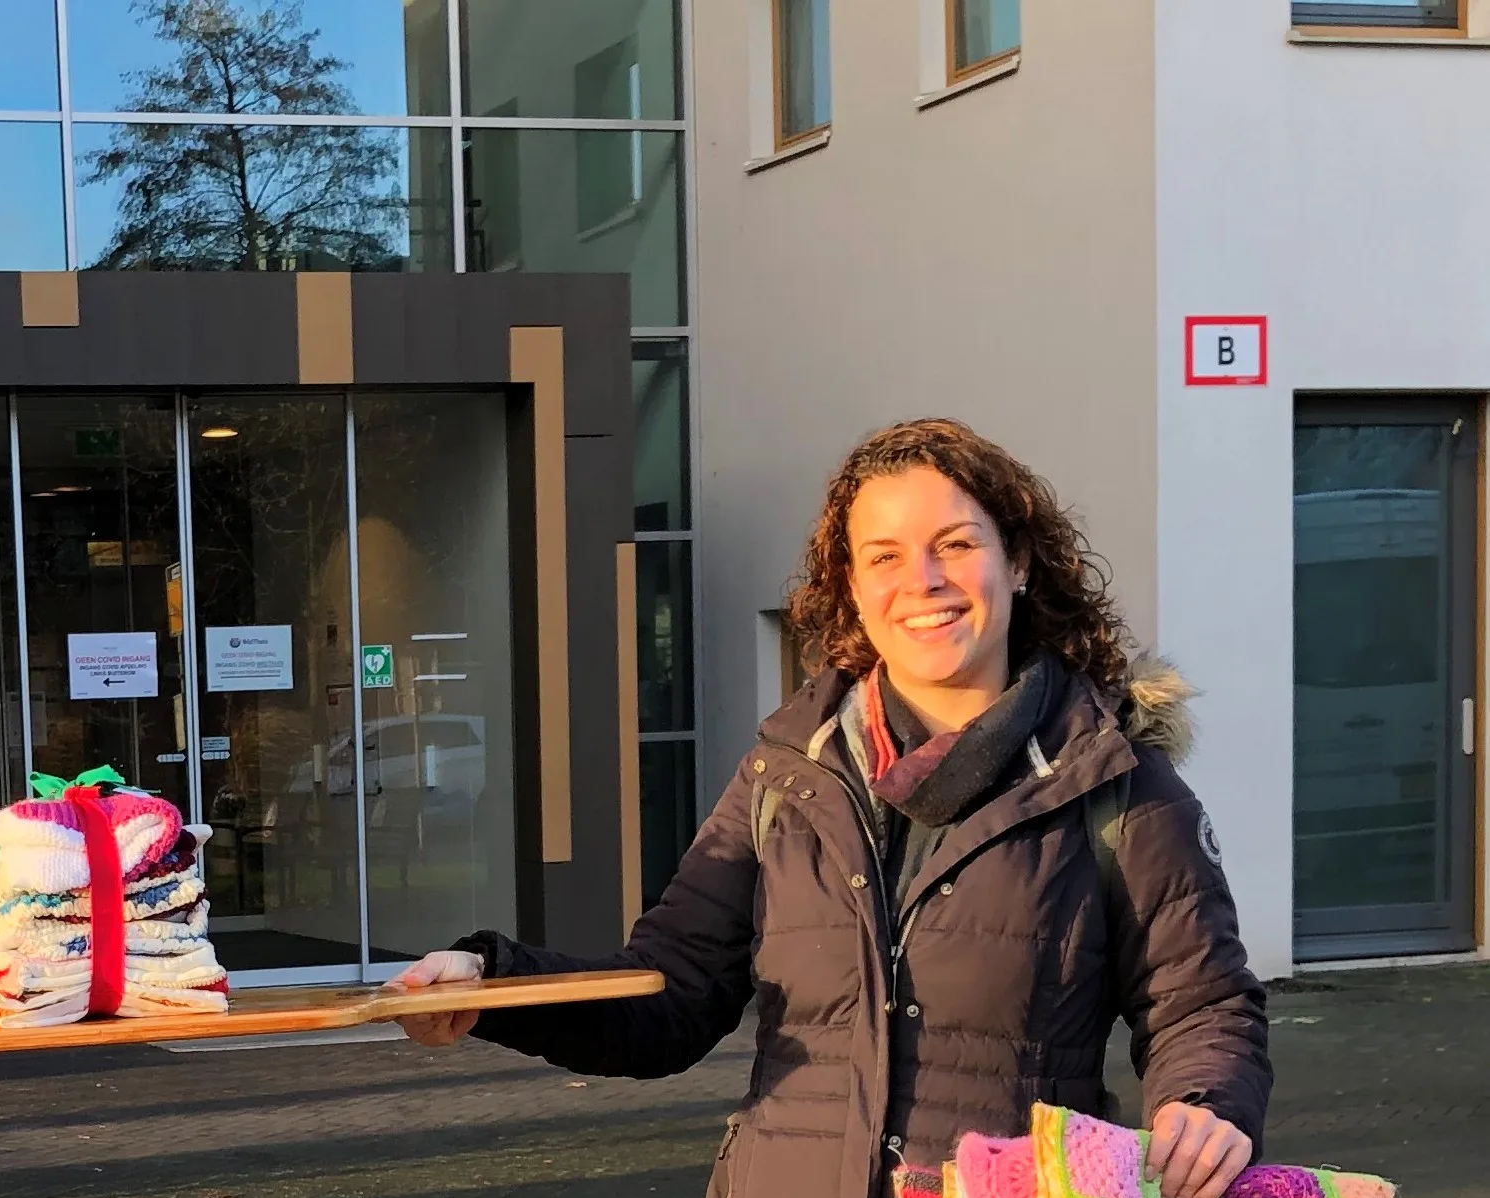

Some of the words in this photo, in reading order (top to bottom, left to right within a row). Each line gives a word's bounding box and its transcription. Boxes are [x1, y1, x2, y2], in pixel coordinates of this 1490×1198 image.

[1217, 336, 1235, 366] B
[75, 656, 97, 664] GEEN
[97, 655, 121, 664] COVID
[121, 654, 151, 663] INGANG
[365, 676, 391, 685] AED
